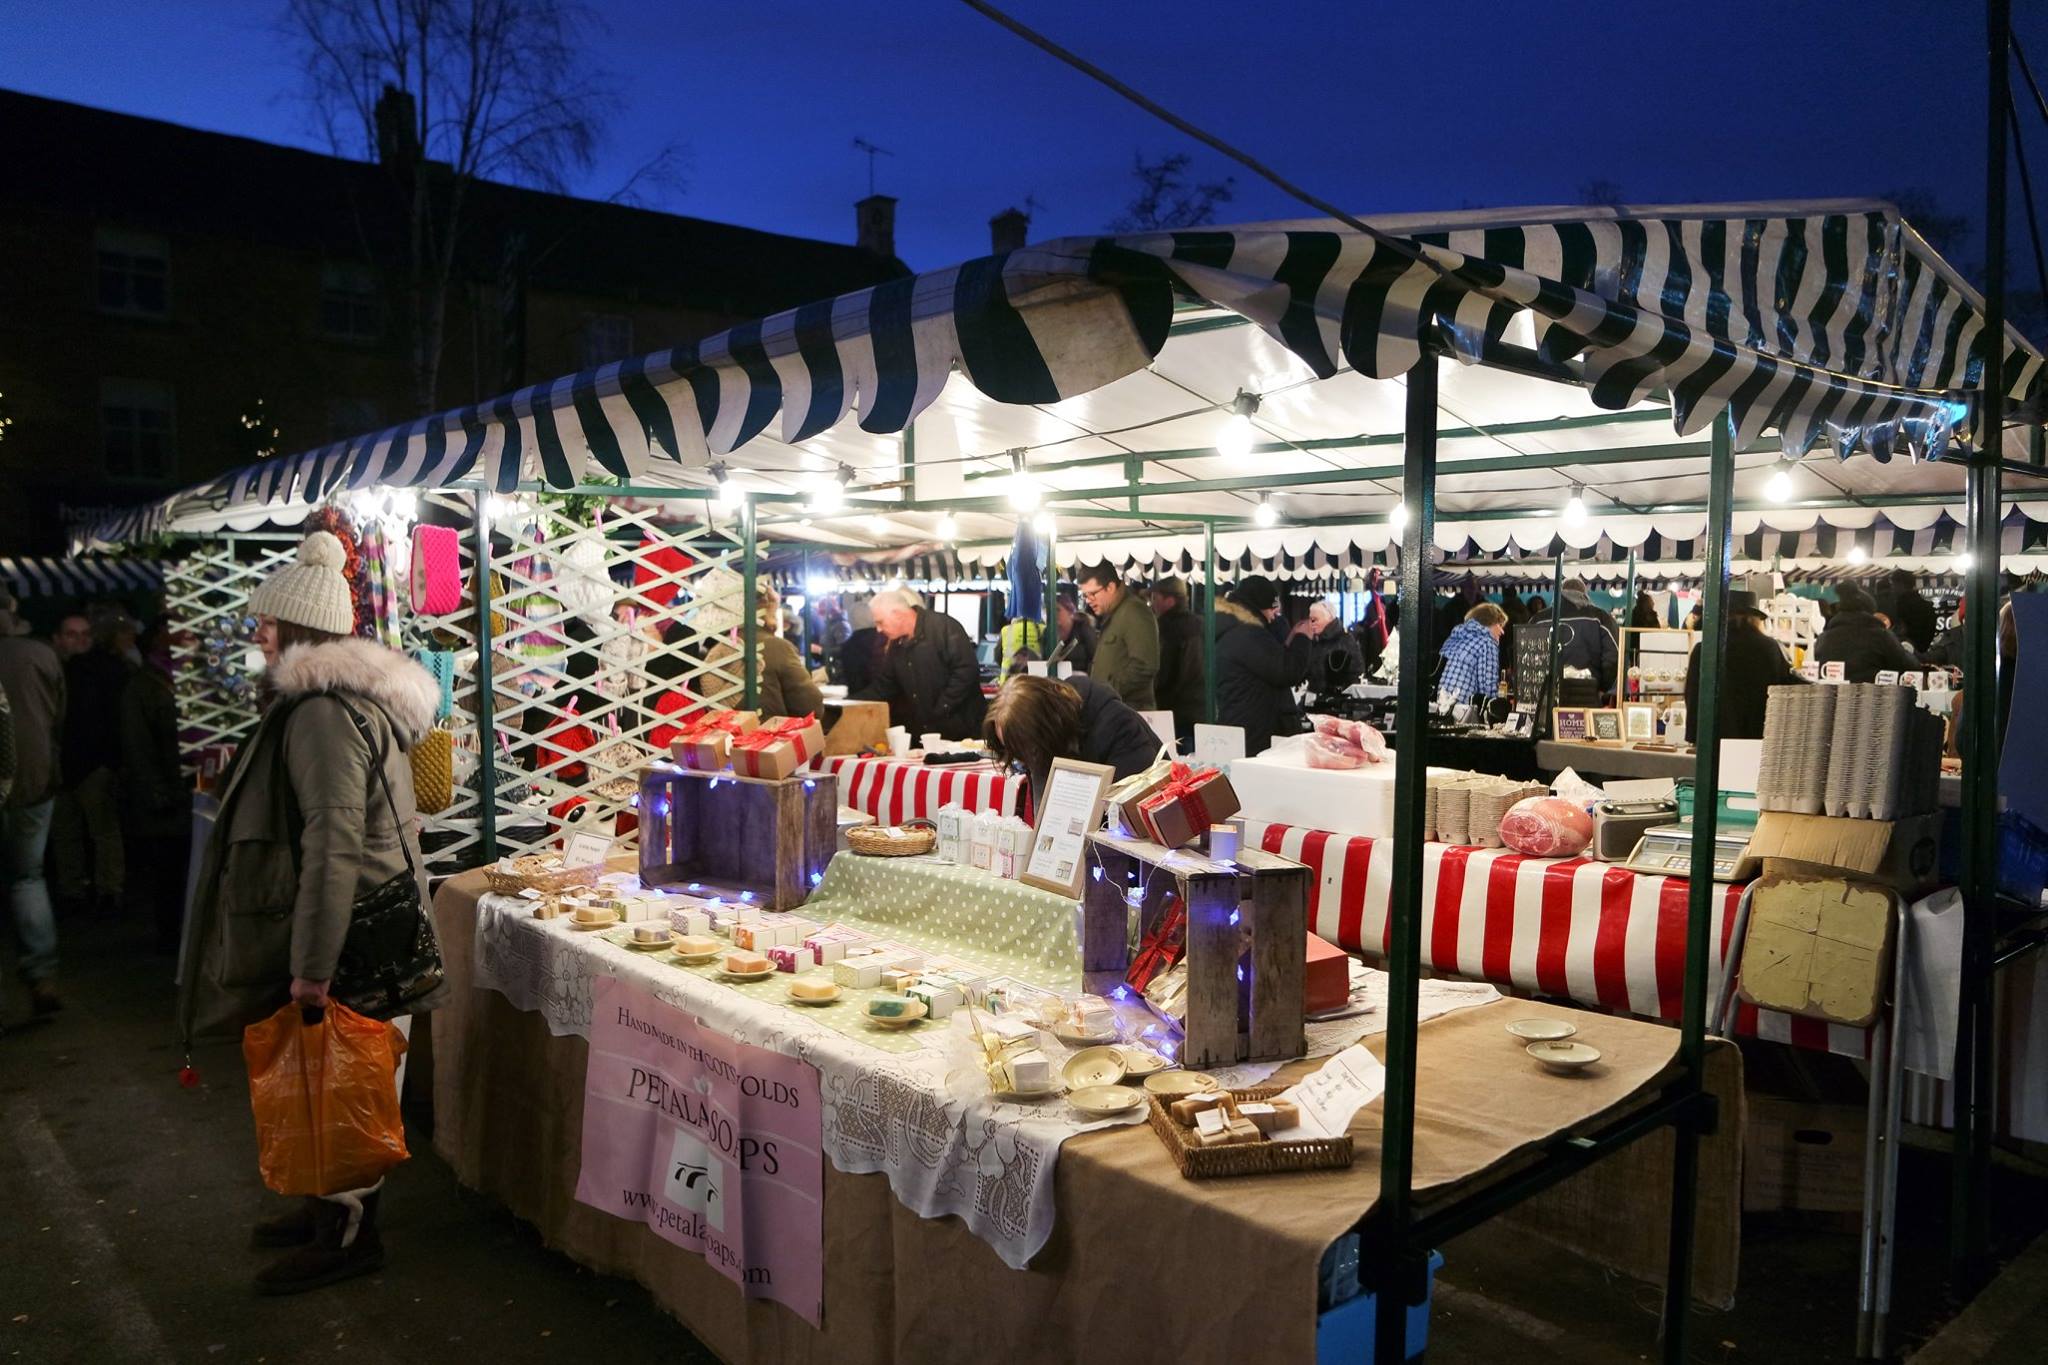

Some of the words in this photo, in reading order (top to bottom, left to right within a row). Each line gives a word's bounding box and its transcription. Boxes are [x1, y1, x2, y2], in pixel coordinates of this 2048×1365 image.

[1559, 719, 1585, 727] HOME
[676, 1038, 688, 1055] IN
[688, 1044, 704, 1062] TH
[704, 1052, 800, 1109] COTSOLDS
